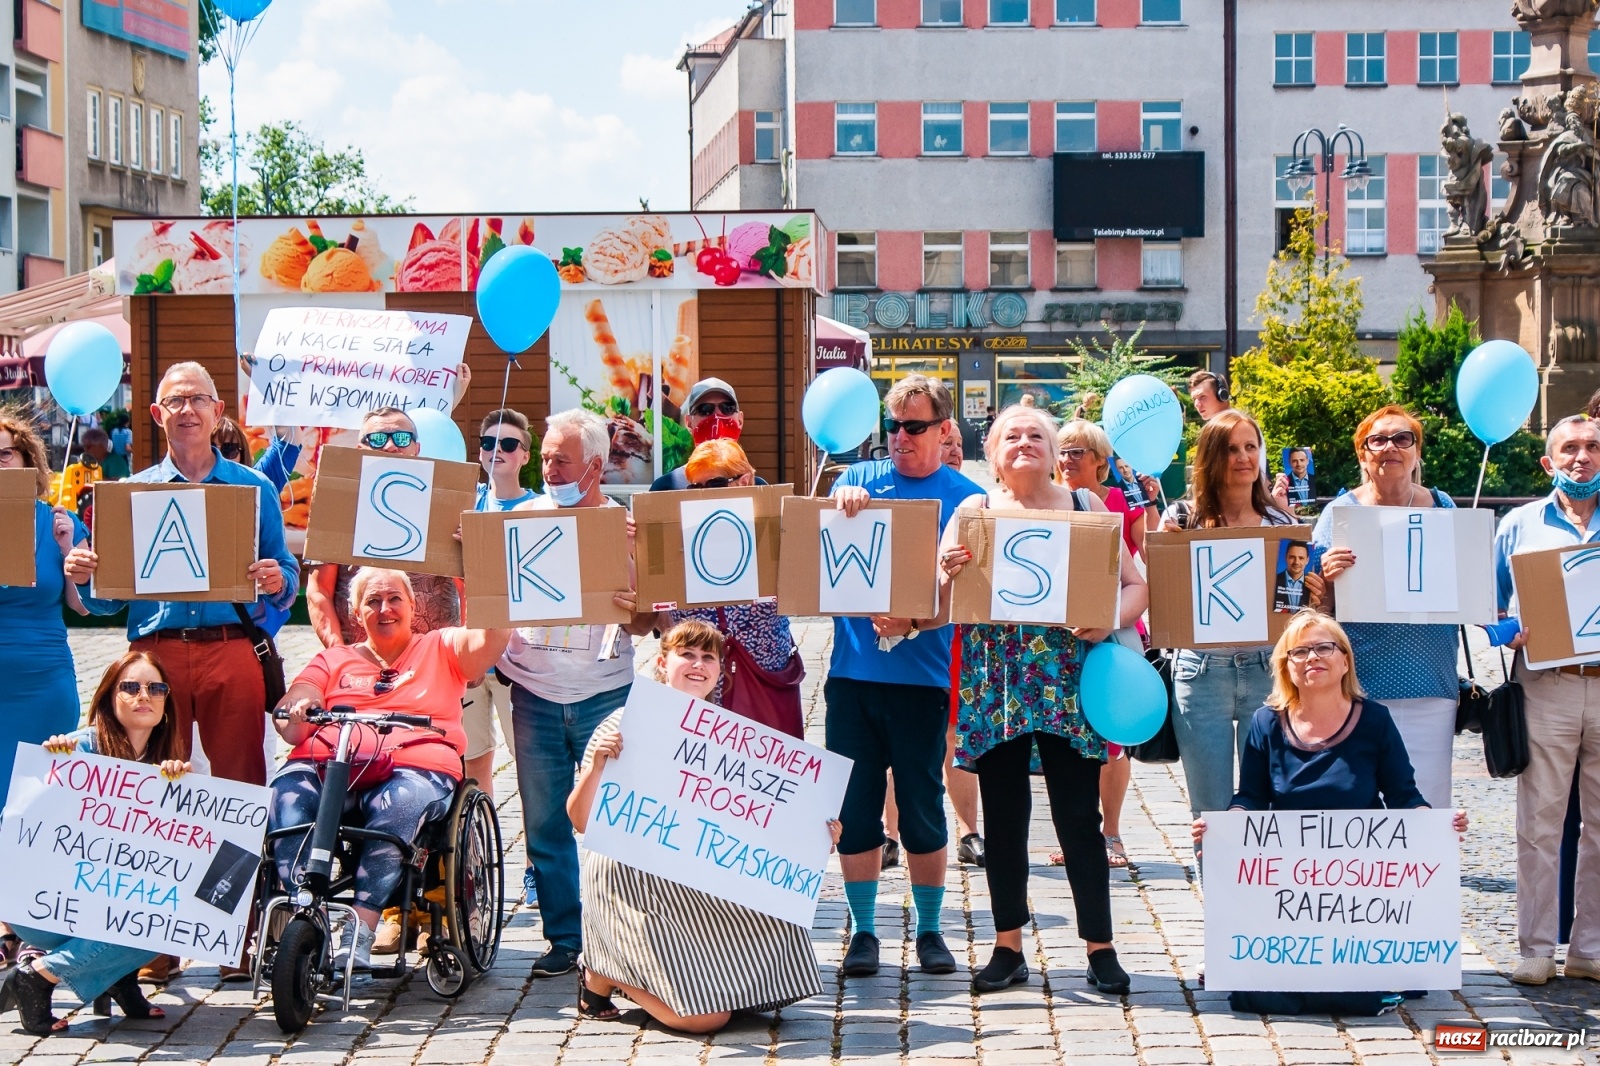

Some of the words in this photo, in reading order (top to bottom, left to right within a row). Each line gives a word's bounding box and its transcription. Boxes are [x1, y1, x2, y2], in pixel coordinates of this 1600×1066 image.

[1093, 228, 1164, 236] Telebimy-Raciborz.pl
[303, 308, 389, 331] PIERWSZA
[392, 315, 448, 336] DAMA
[834, 292, 1027, 329] BOLKO
[1042, 301, 1184, 328] zaprasza
[276, 332, 292, 347] W
[373, 336, 434, 356] STAŁA
[816, 345, 847, 360] Italia
[872, 338, 974, 350] ELIKATESY
[4, 366, 28, 380] Italia
[269, 354, 286, 372] O
[302, 354, 383, 380] PRAWACH
[390, 365, 458, 389] KOBIET
[362, 471, 427, 558] S
[140, 497, 206, 579] A
[691, 509, 753, 586] O
[821, 521, 886, 588] W
[508, 526, 566, 602] K
[998, 528, 1052, 605] S
[1196, 546, 1254, 626] K
[680, 699, 822, 783] LEKARSTWEM
[673, 738, 708, 771] NA
[714, 754, 799, 804] NASZE
[160, 782, 268, 828] MARNEGO
[596, 782, 680, 851] RAFAŁ
[18, 818, 42, 848] W
[1244, 812, 1282, 848] NA
[74, 862, 180, 912] RAFAŁA
[1294, 858, 1440, 888] GŁOSUJEMY
[1229, 935, 1324, 965] DOBRZE
